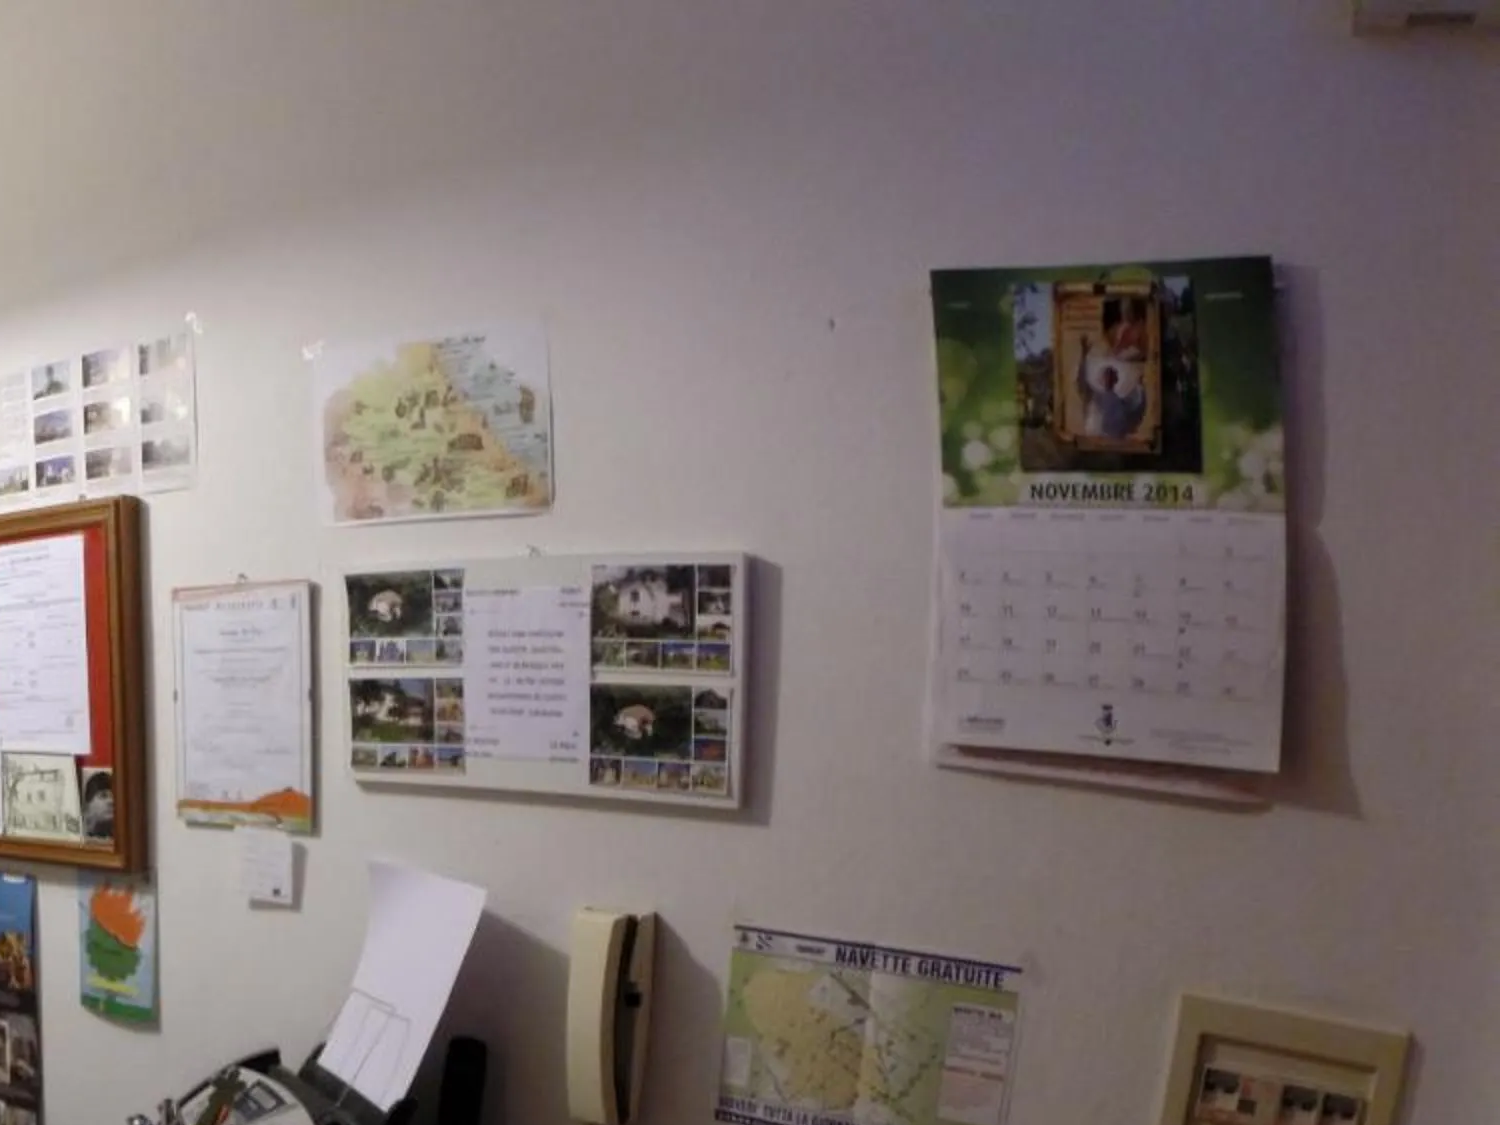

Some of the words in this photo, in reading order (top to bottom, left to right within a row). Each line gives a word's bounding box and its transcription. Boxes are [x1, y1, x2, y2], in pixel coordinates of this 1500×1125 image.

[1030, 482, 1134, 501] NOVEMBRE
[1143, 484, 1195, 504] 2014
[835, 943, 911, 976] NAVETTE
[917, 956, 1004, 990] GRATUITE
